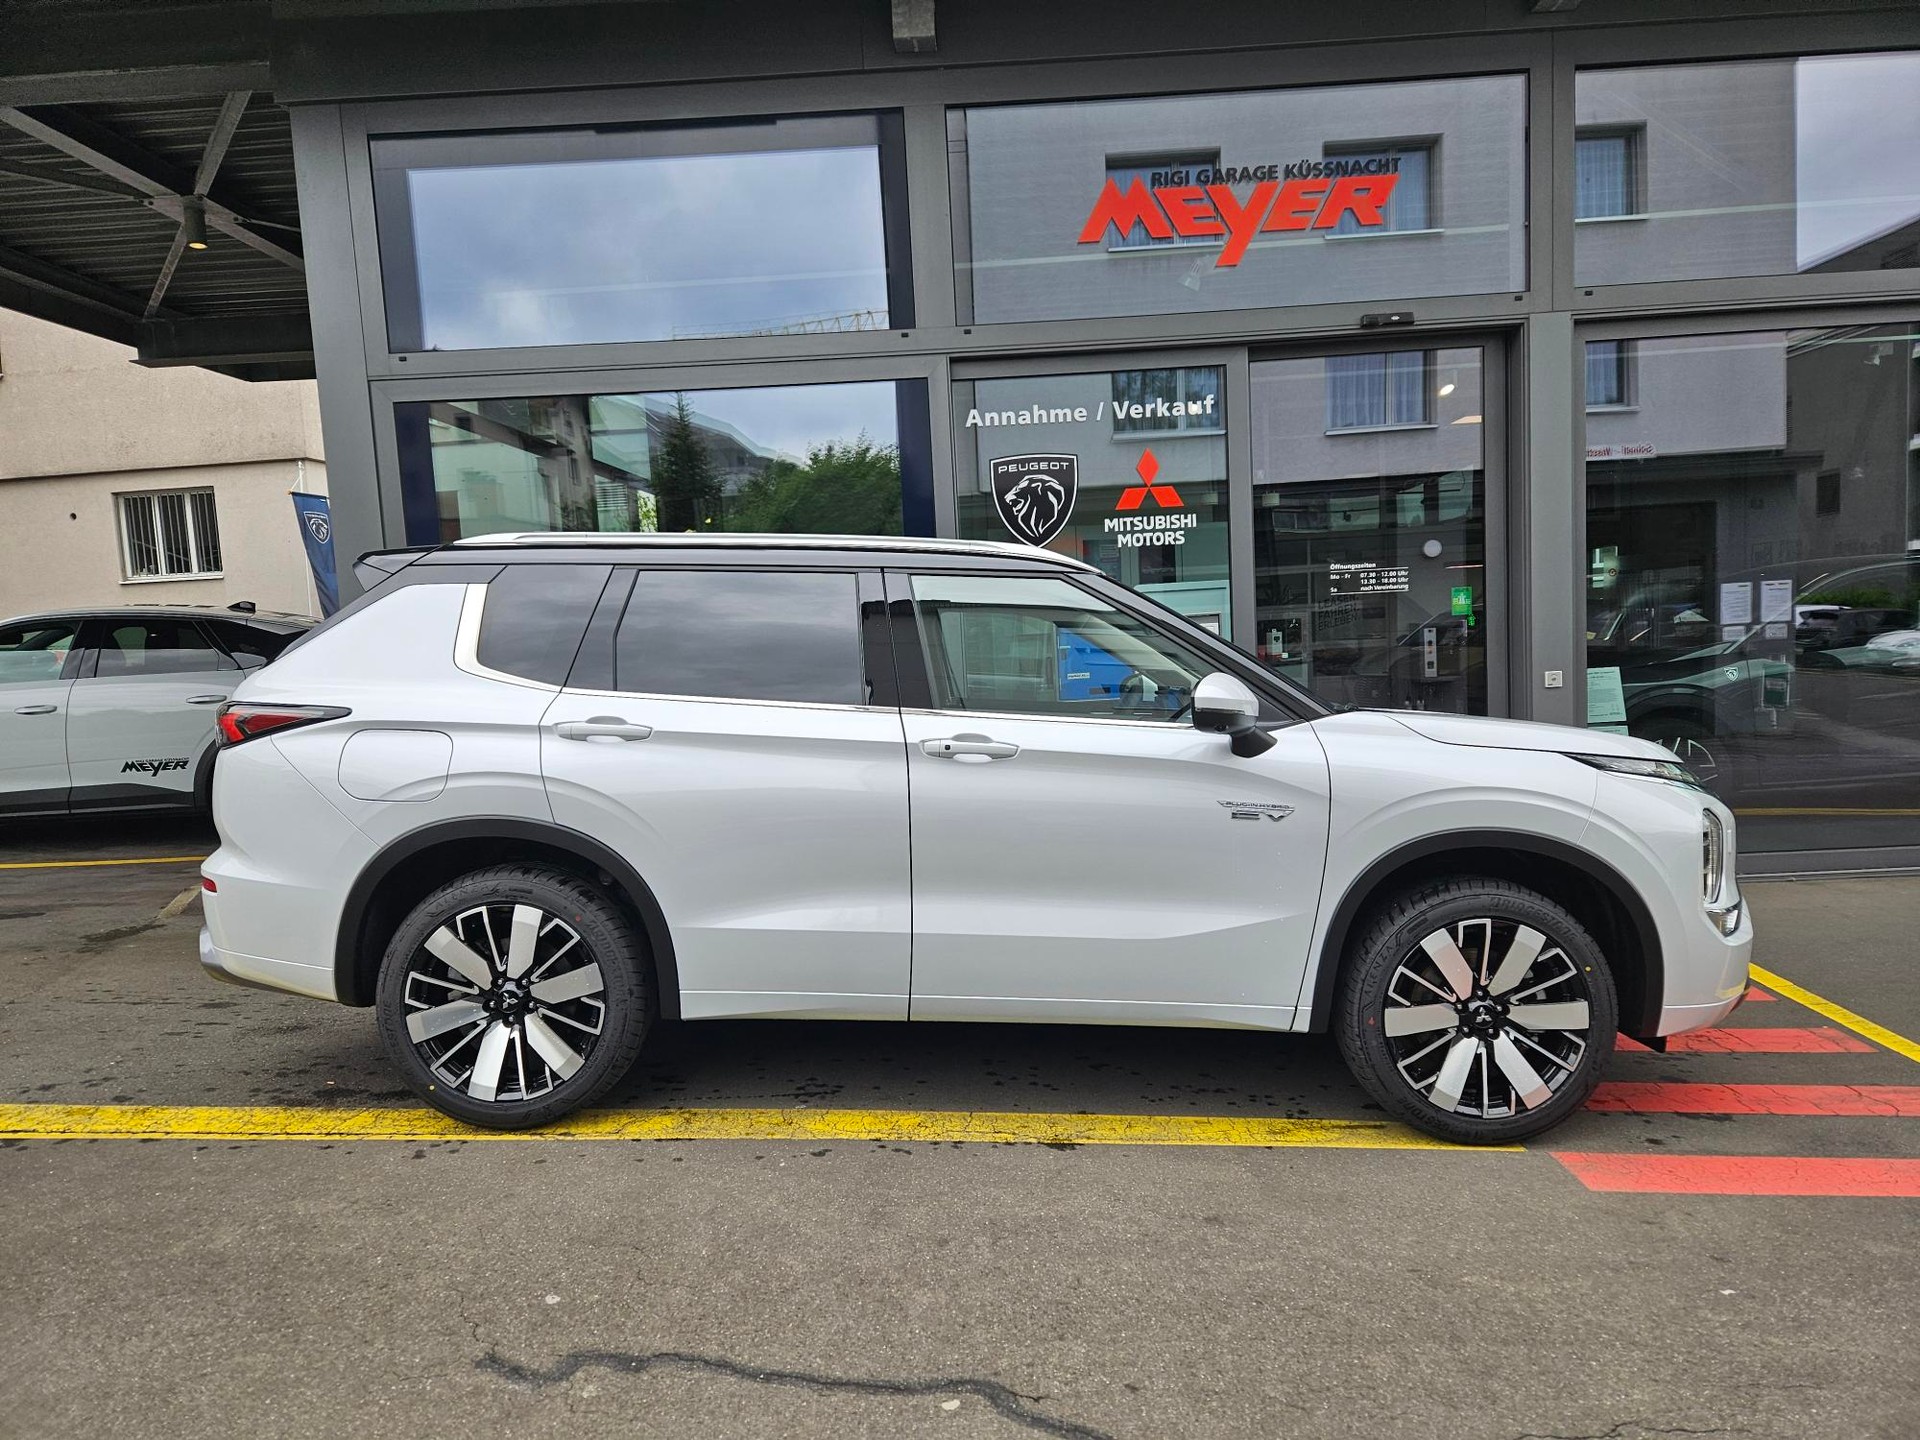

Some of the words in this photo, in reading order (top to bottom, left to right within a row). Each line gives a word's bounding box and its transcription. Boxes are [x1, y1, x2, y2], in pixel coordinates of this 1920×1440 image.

[1151, 169, 1190, 188] RIGI
[1196, 164, 1279, 186] GARAGE
[1284, 157, 1401, 181] KÜSSNACHT
[1077, 173, 1399, 267] MEYER
[965, 404, 1088, 428] Annahme
[1096, 401, 1104, 421] /
[1112, 394, 1215, 421] Verkauf
[998, 461, 1070, 474] PEUGEOT
[1104, 513, 1197, 533] MITSUBISHI
[1117, 530, 1186, 548] MOTORS
[1330, 562, 1376, 570] Öffnungszeiten
[121, 760, 189, 777] MEYER
